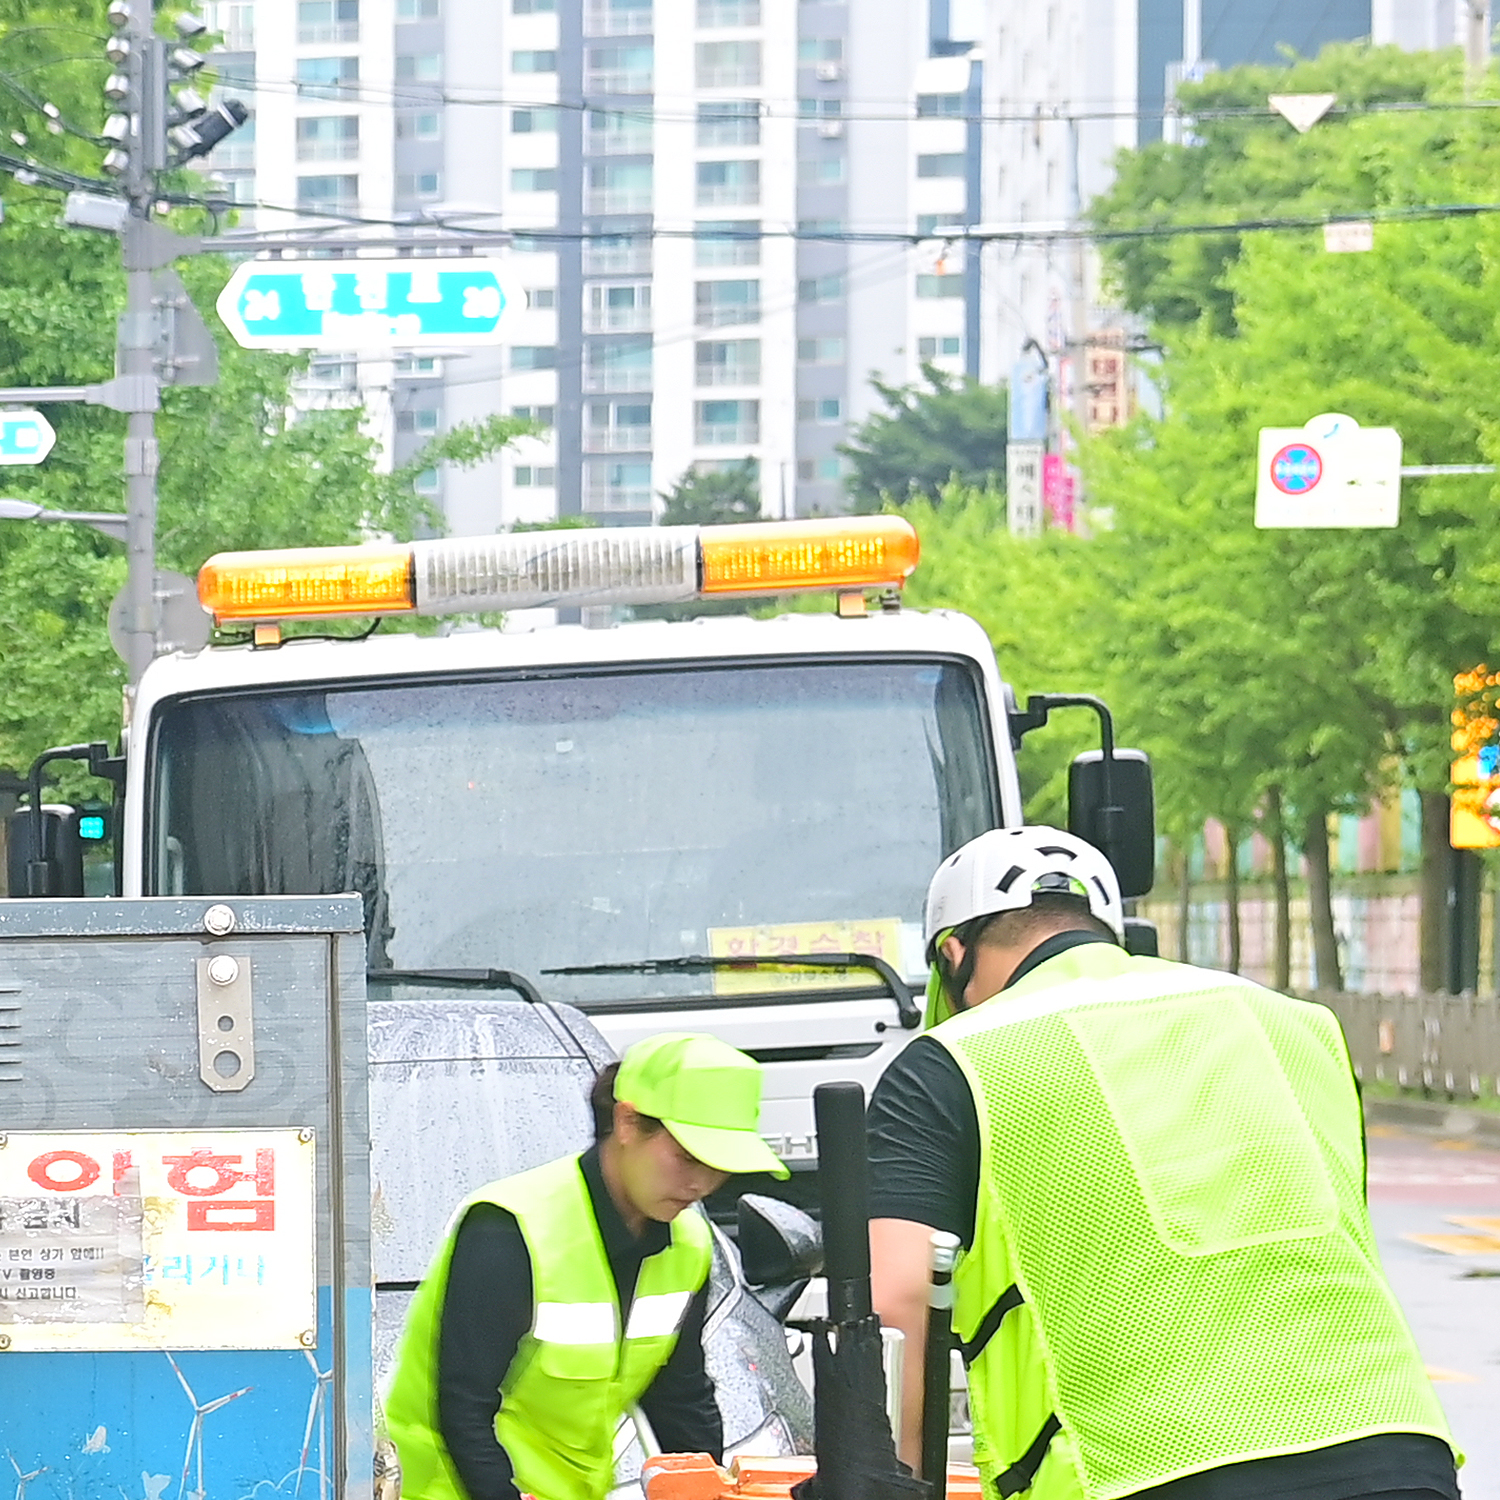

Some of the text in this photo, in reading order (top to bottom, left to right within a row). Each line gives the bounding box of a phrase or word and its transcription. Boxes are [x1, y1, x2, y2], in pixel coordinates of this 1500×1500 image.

[40, 1247, 64, 1261] 상가
[19, 1267, 56, 1281] 촬영중
[143, 1254, 266, 1286] 리거나
